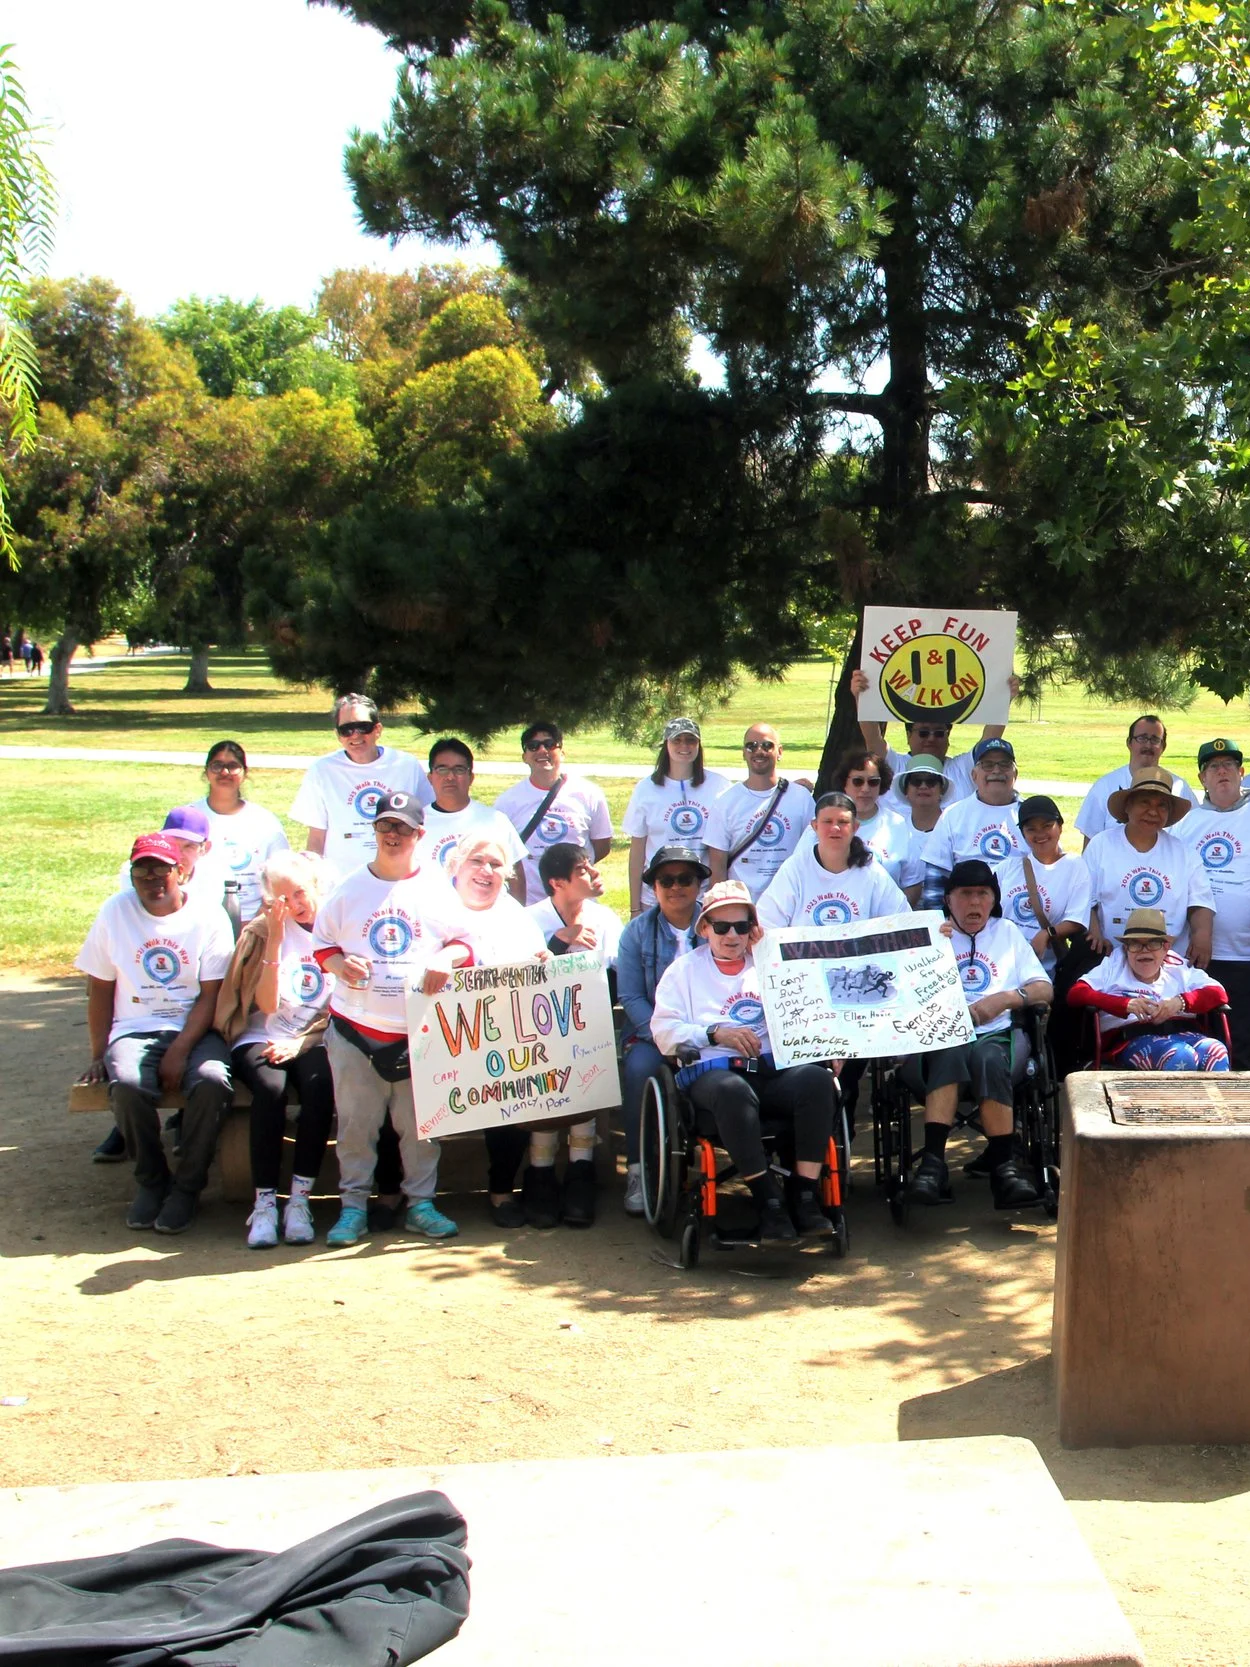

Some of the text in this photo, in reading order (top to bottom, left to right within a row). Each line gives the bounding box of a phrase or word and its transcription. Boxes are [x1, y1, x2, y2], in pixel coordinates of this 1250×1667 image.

[869, 617, 990, 664] KEEP FUN
[927, 650, 943, 665] &
[889, 669, 978, 706] WALK ON
[981, 824, 997, 834] Walk
[1204, 831, 1221, 840] Walk
[1223, 831, 1235, 842] This
[440, 835, 455, 845] Walk
[805, 891, 860, 916] 2025 Walk This Way
[372, 908, 393, 919] Walk
[163, 939, 179, 949] This
[179, 948, 190, 965] Way
[975, 952, 989, 962] This
[990, 962, 999, 977] Way
[768, 975, 778, 989] I
[745, 991, 760, 1001] This
[779, 985, 804, 999] But
[435, 984, 586, 1057] WE LOVE
[782, 1012, 837, 1029] Holly 2025
[844, 1012, 867, 1021] Ellen
[486, 1042, 549, 1078] OUR
[449, 1066, 572, 1115] COMMUNITY
